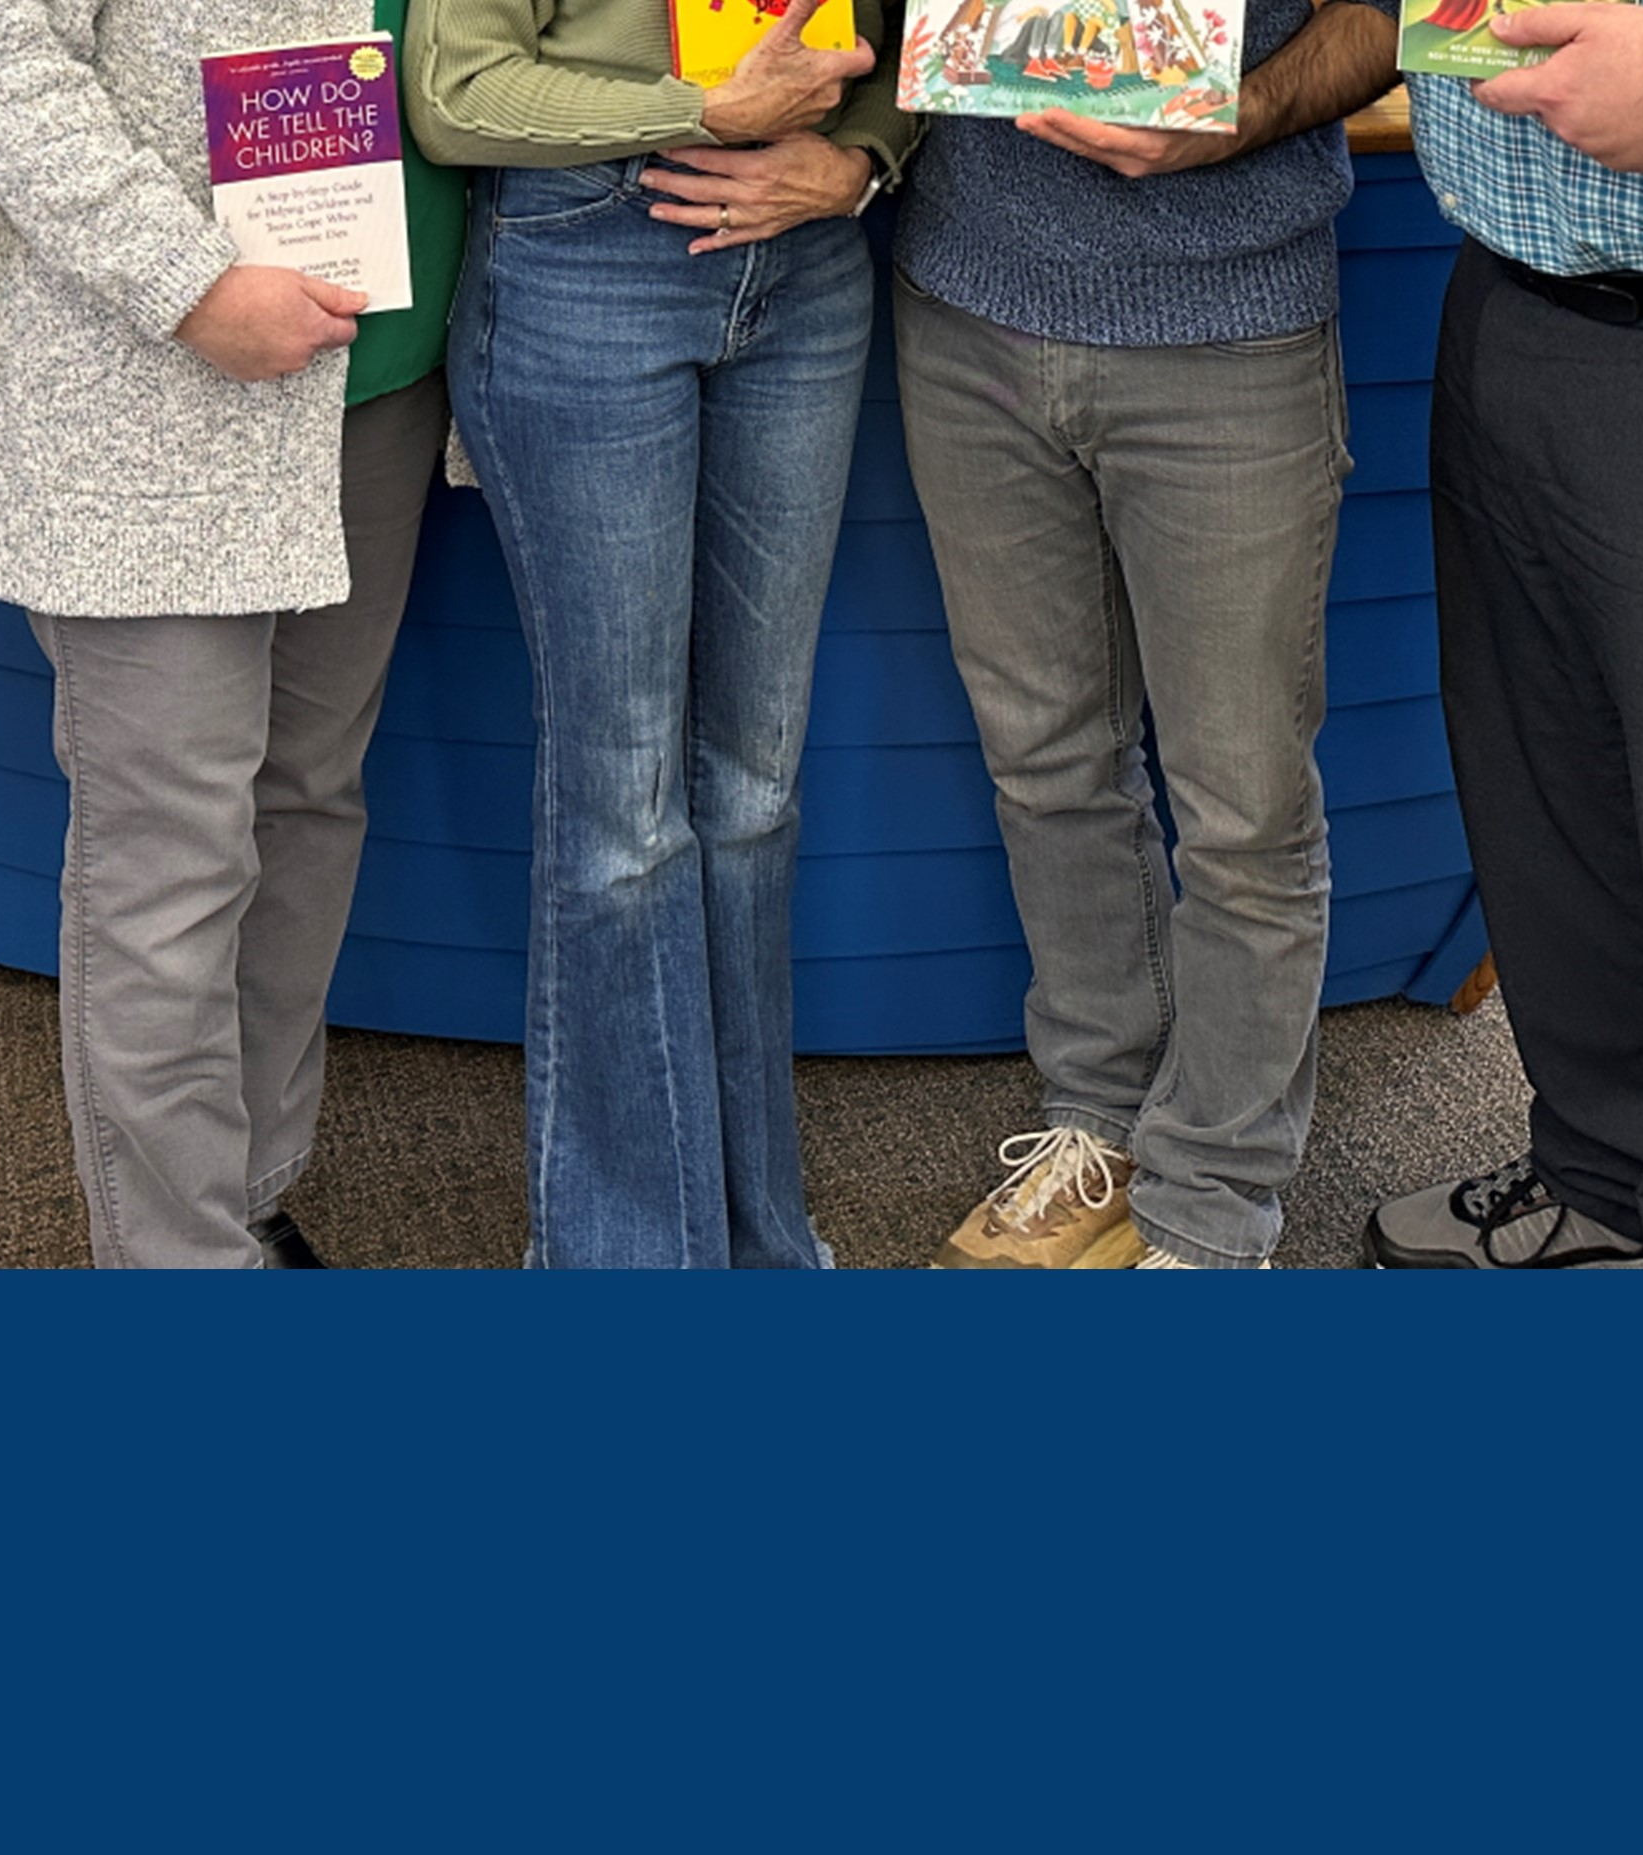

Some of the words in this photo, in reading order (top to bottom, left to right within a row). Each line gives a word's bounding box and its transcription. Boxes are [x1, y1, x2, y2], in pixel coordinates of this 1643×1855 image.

[241, 86, 310, 114] HOW
[321, 79, 361, 104] DO
[227, 116, 269, 143] WE
[280, 111, 327, 136] TELL
[334, 104, 378, 128] THE
[235, 129, 375, 169] CHILDREN?
